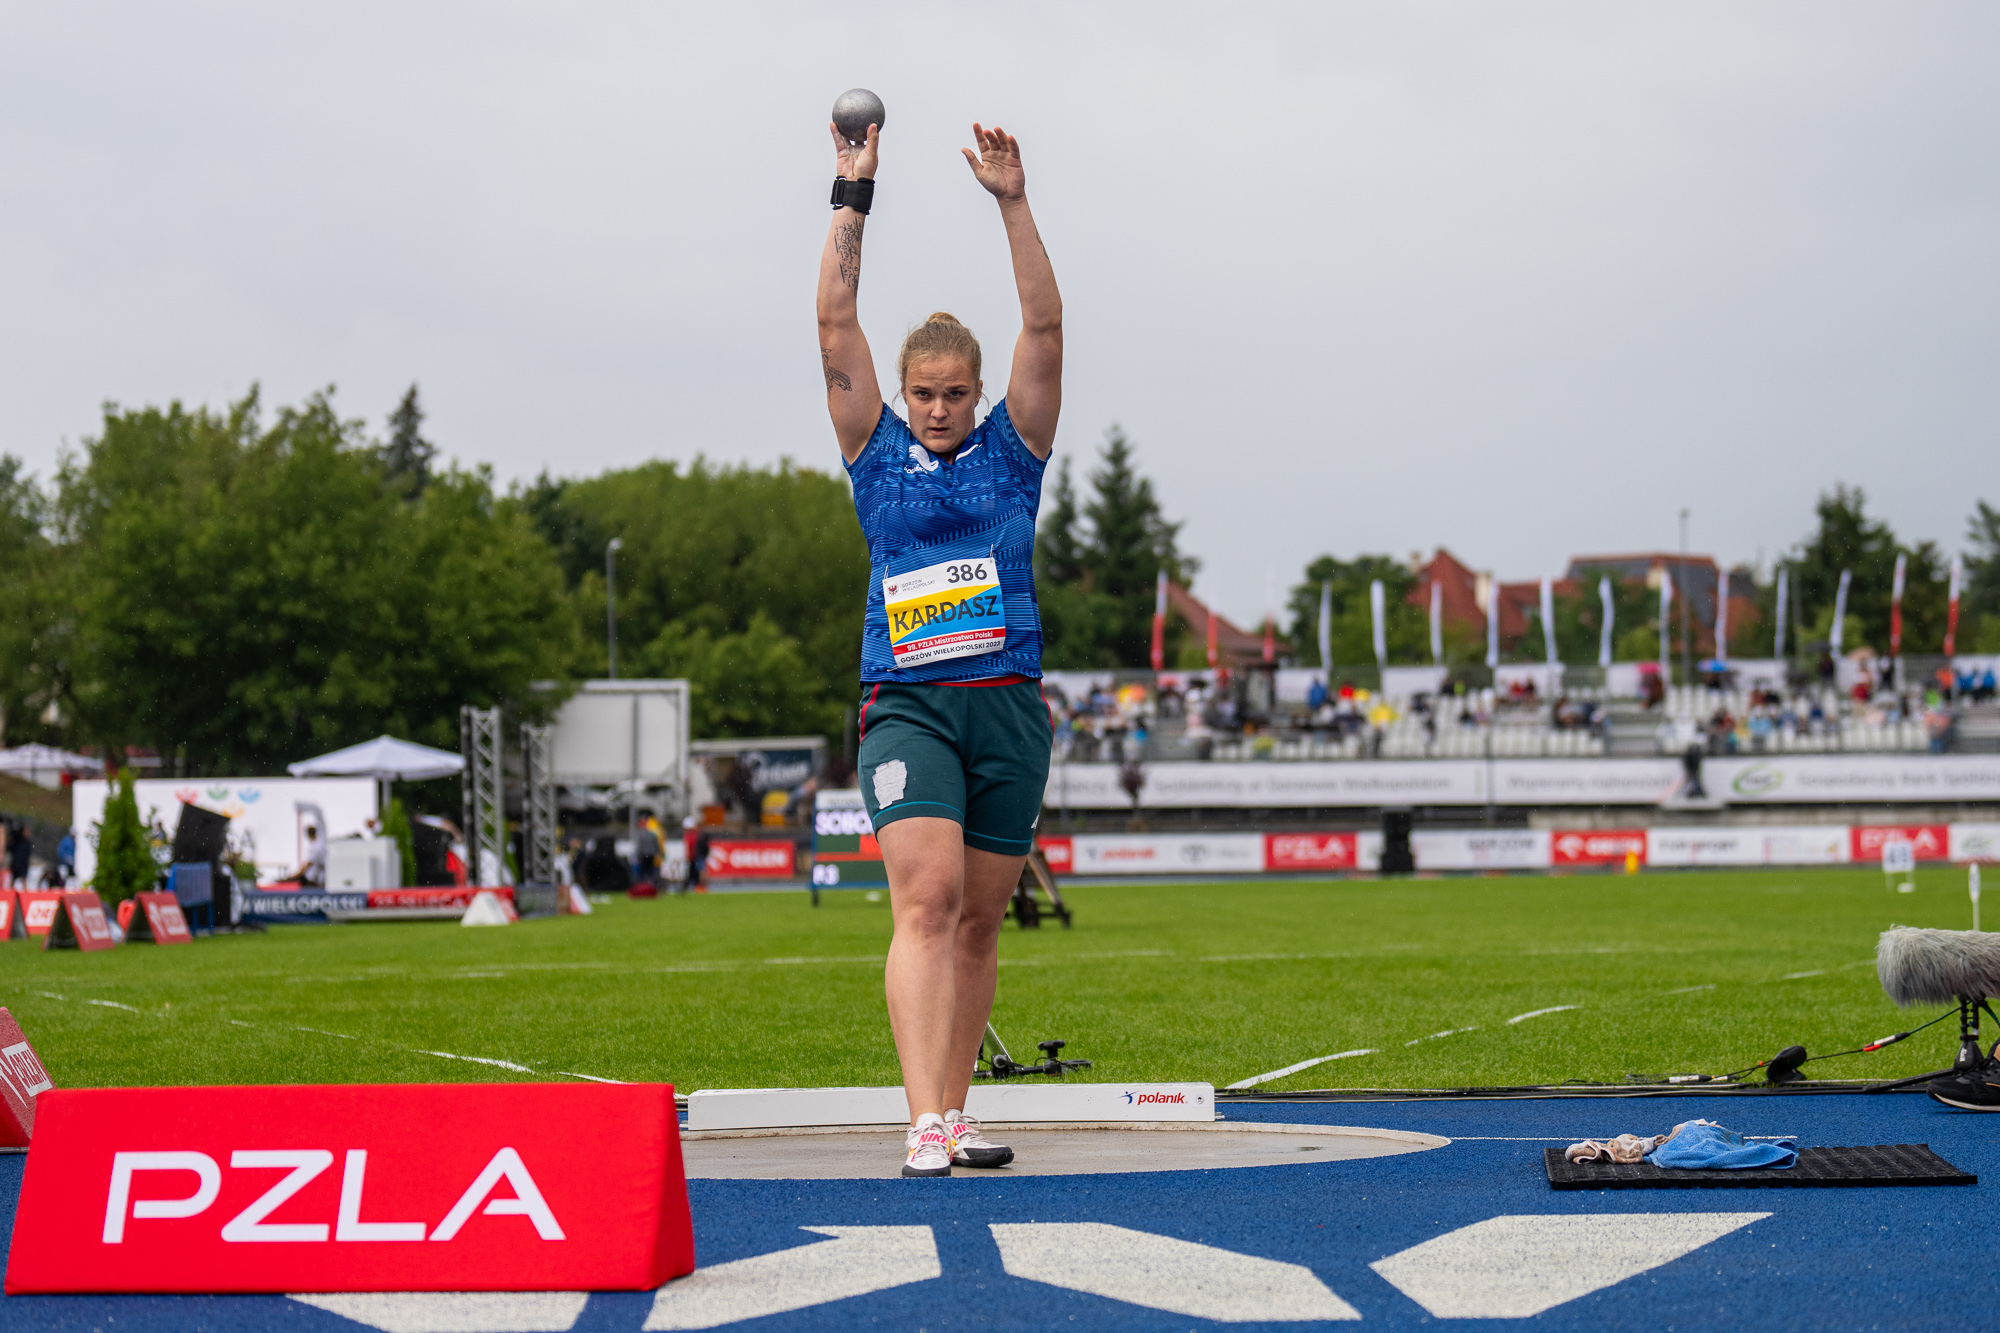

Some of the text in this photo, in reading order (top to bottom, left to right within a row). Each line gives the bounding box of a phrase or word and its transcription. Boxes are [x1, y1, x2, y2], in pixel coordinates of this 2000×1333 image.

[946, 563, 988, 584] 386
[893, 595, 1000, 633] KARDASZ
[918, 641, 934, 649] PZLA
[934, 633, 974, 645] Mistrzostwa
[975, 631, 994, 639] Polski
[900, 651, 932, 663] GORZÓW
[933, 643, 985, 656] WIELKOPOLSKI
[1860, 828, 1938, 851] PZA
[1137, 1091, 1186, 1106] polanik
[917, 1132, 948, 1146] NIKE
[102, 1147, 566, 1244] PZLA
